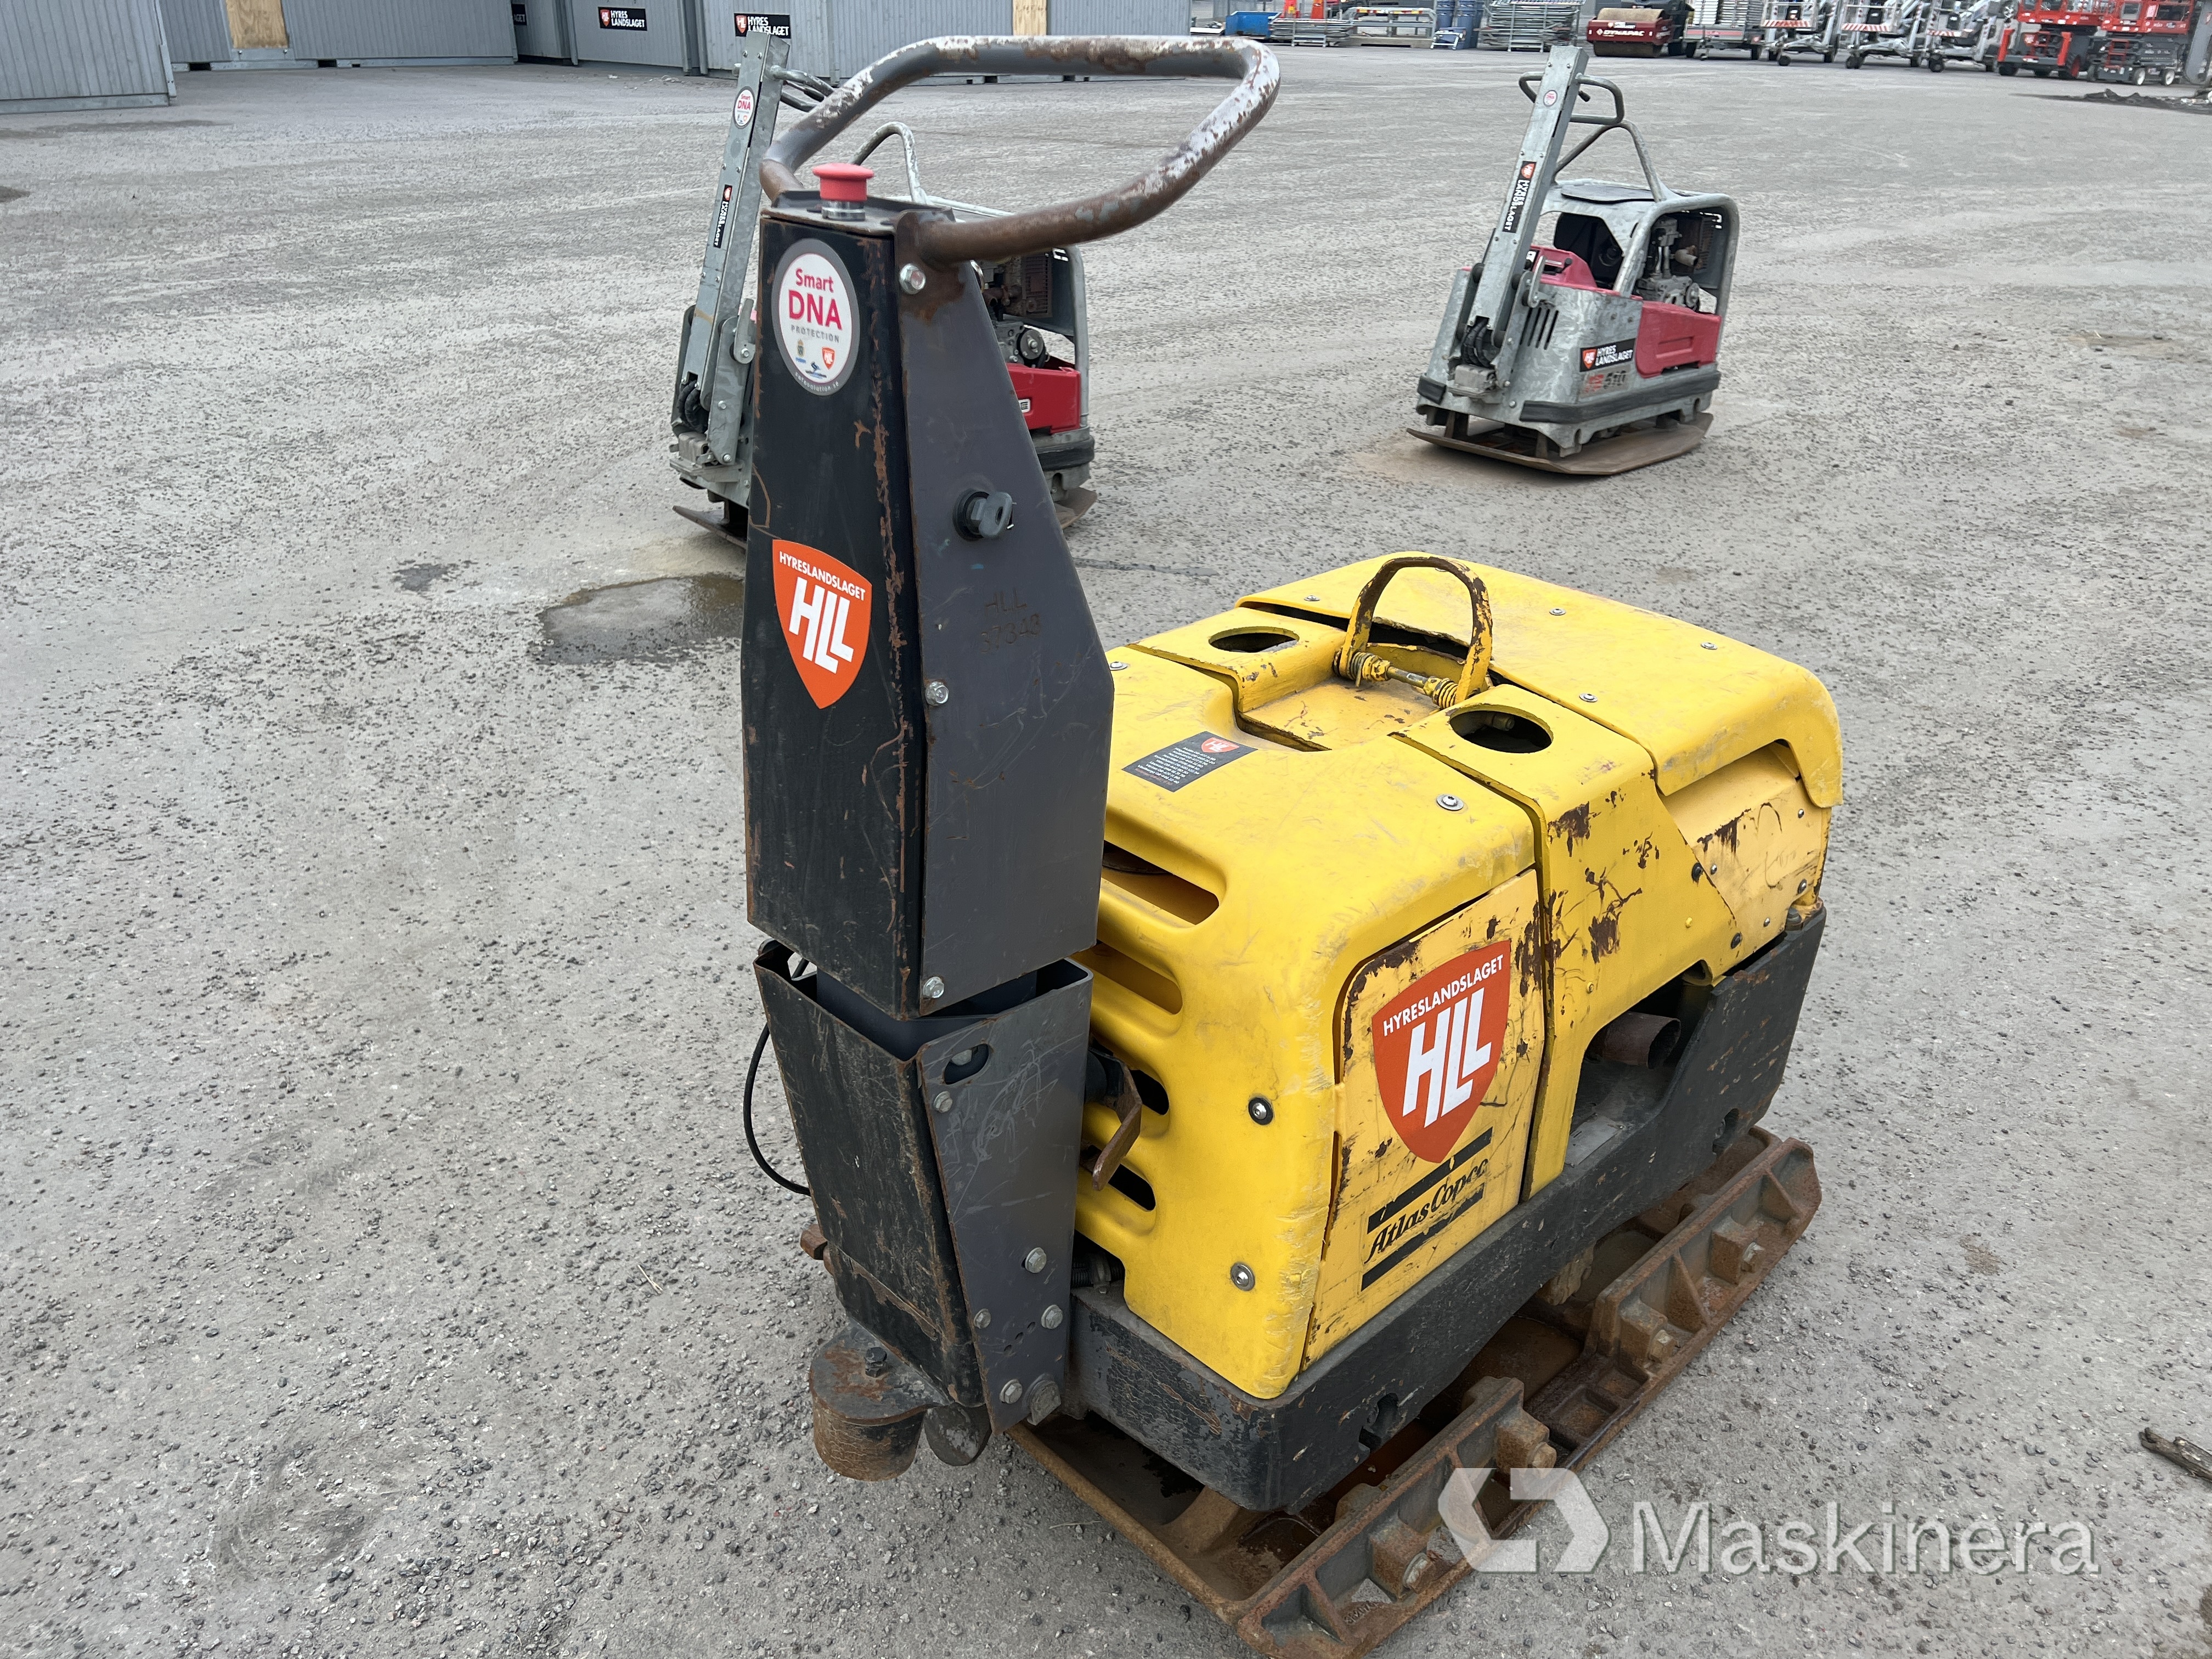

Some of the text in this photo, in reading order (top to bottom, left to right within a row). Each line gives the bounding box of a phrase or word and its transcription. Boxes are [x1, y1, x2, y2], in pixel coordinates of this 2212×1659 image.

[611, 19, 645, 28] LANDSLAGET
[737, 100, 751, 110] DNA
[795, 268, 834, 292] Smart
[788, 289, 843, 330] DNA
[791, 324, 839, 343] PROTECTION
[779, 551, 866, 601] HYRESLANDSLAGET
[788, 576, 854, 674] HLL
[1383, 954, 1504, 1037] HYRESLANDSLAGET
[1402, 988, 1492, 1128] HLL
[1431, 1158, 1489, 1213] Copco
[1364, 1203, 1430, 1264] Atlas
